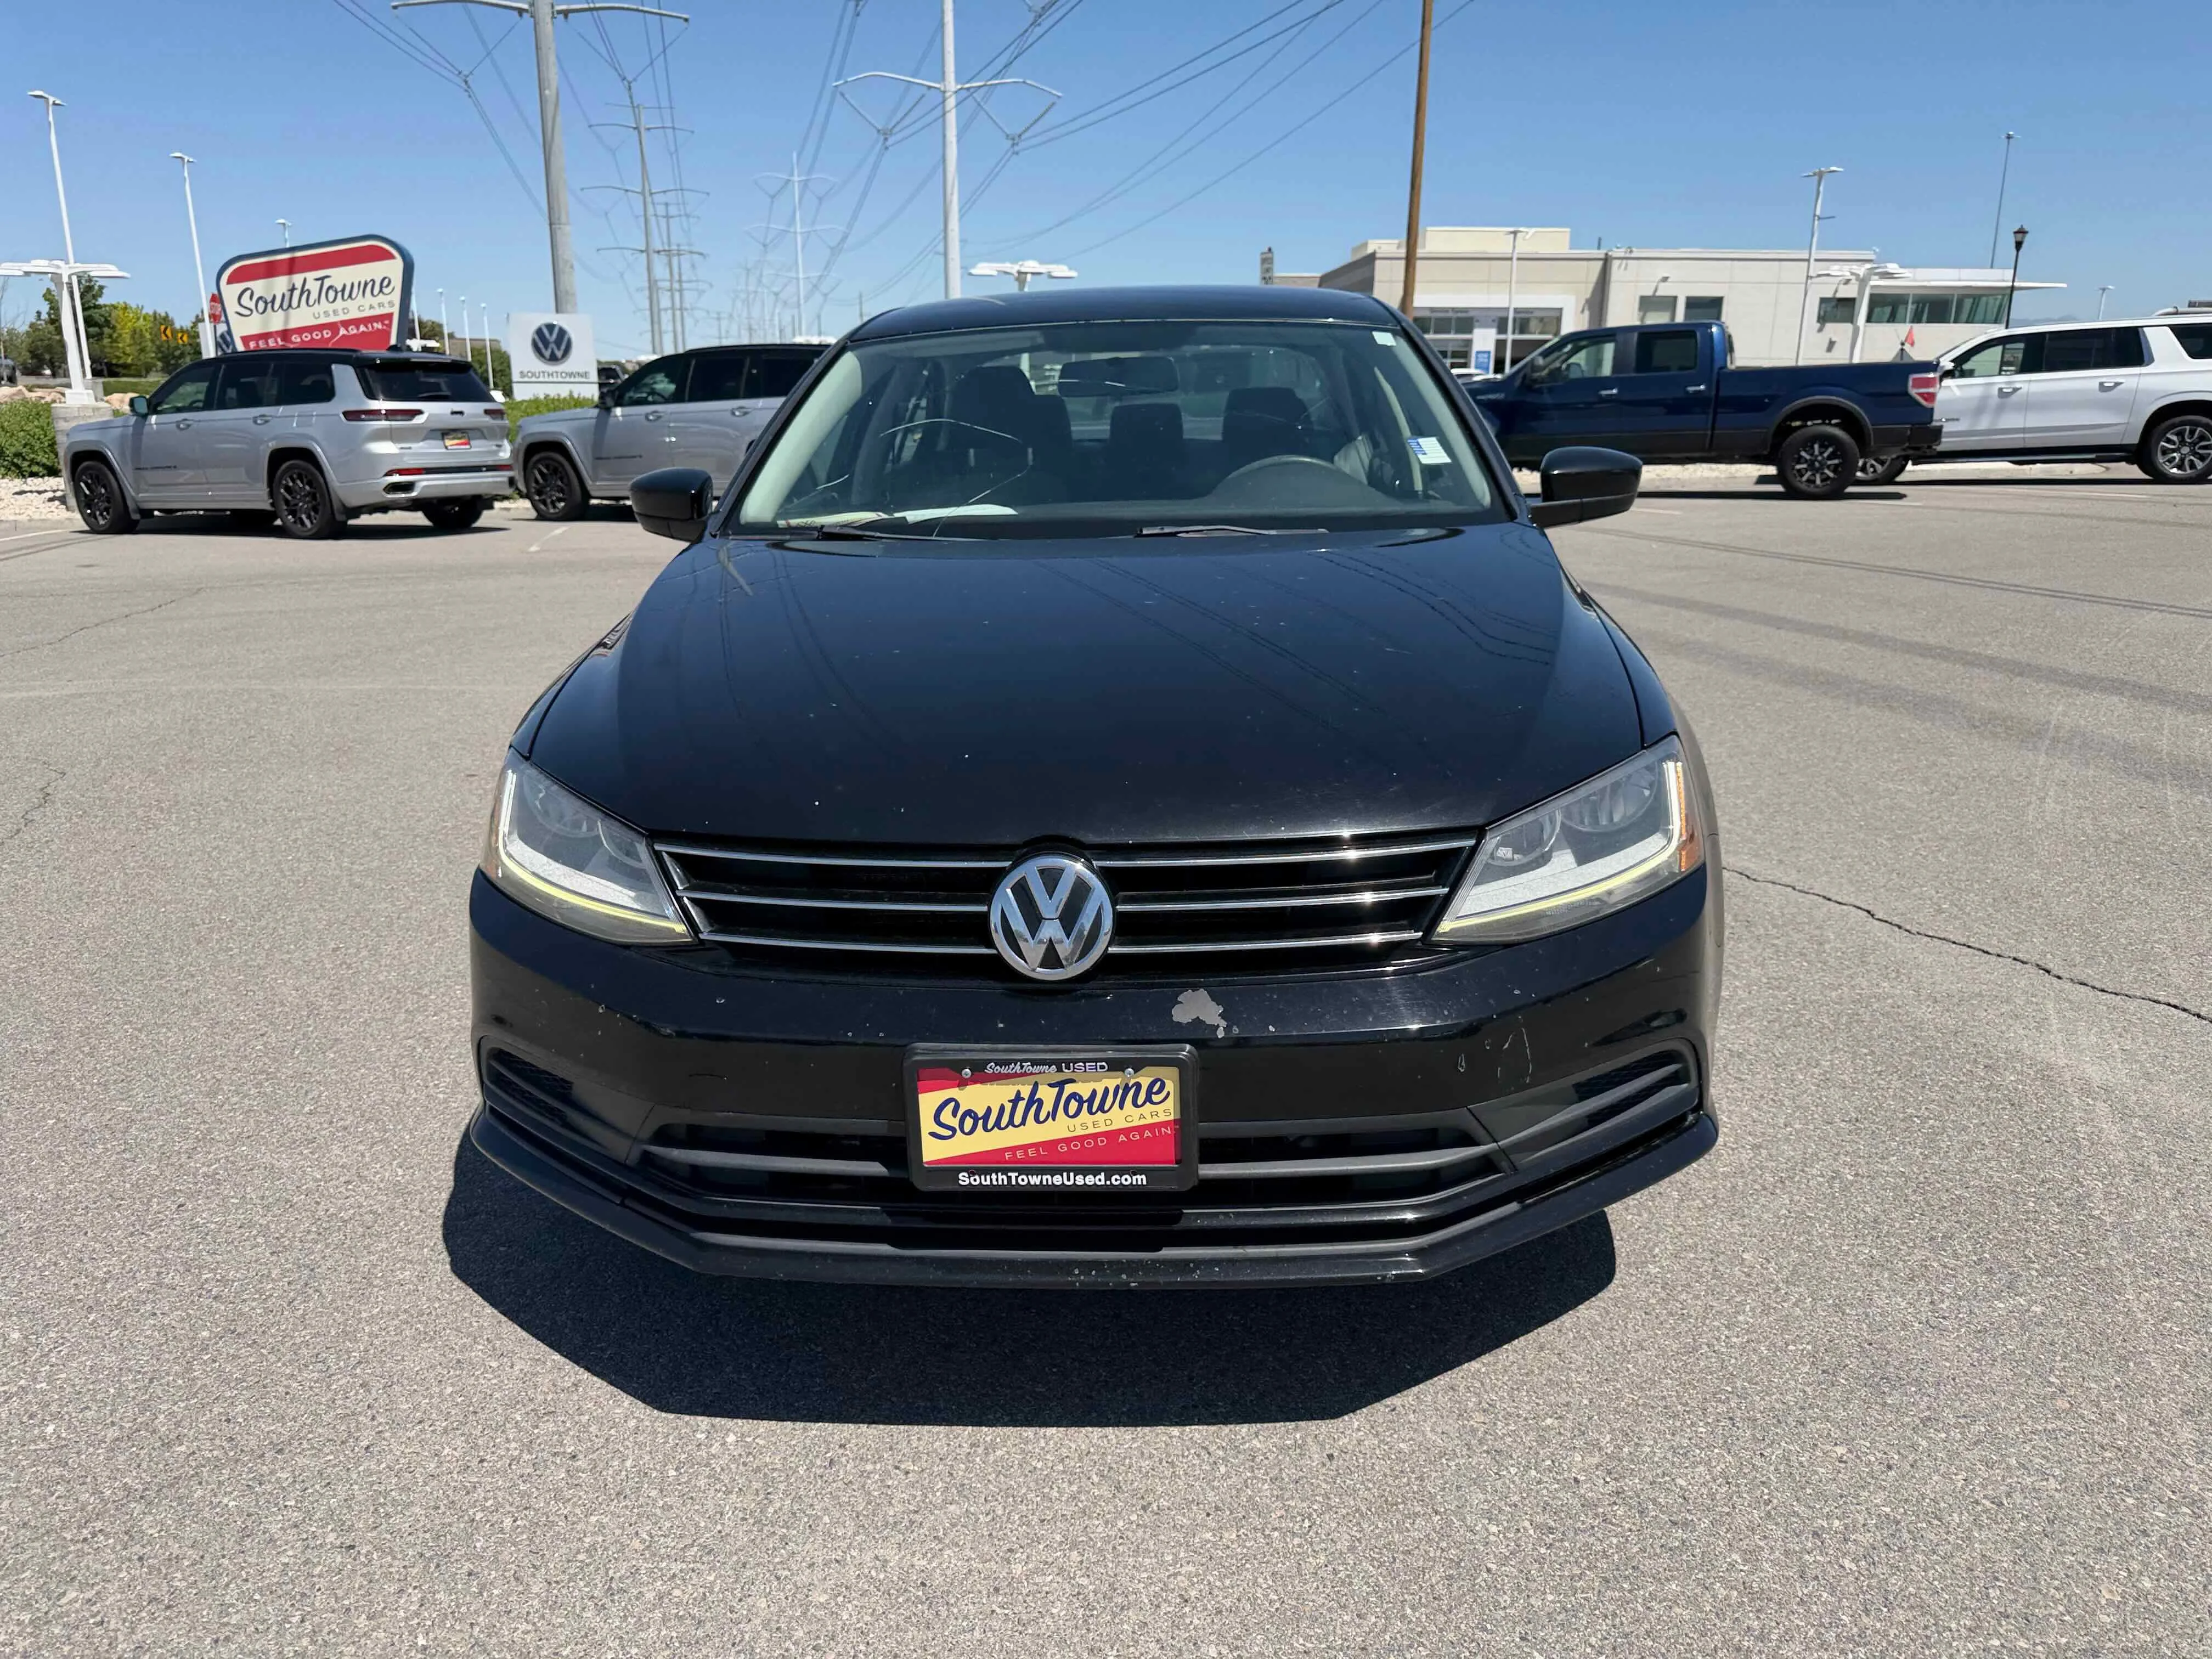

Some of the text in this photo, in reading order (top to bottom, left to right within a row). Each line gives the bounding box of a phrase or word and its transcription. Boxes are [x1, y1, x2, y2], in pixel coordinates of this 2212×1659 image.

[235, 275, 396, 317] SouthTowne
[313, 300, 396, 319] USED CARS
[249, 338, 284, 349] FEEL
[291, 329, 331, 343] GOOD
[519, 370, 590, 379] SOUTHTOWNE
[984, 1062, 1108, 1074] SouthTowne USED
[928, 1077, 1170, 1140] SouthTowne
[1067, 1109, 1172, 1132] USED CARS
[1005, 1147, 1048, 1160] FEEL
[1058, 1137, 1107, 1152] GOOD
[958, 1172, 1147, 1186] SouthTowneUsed.com
